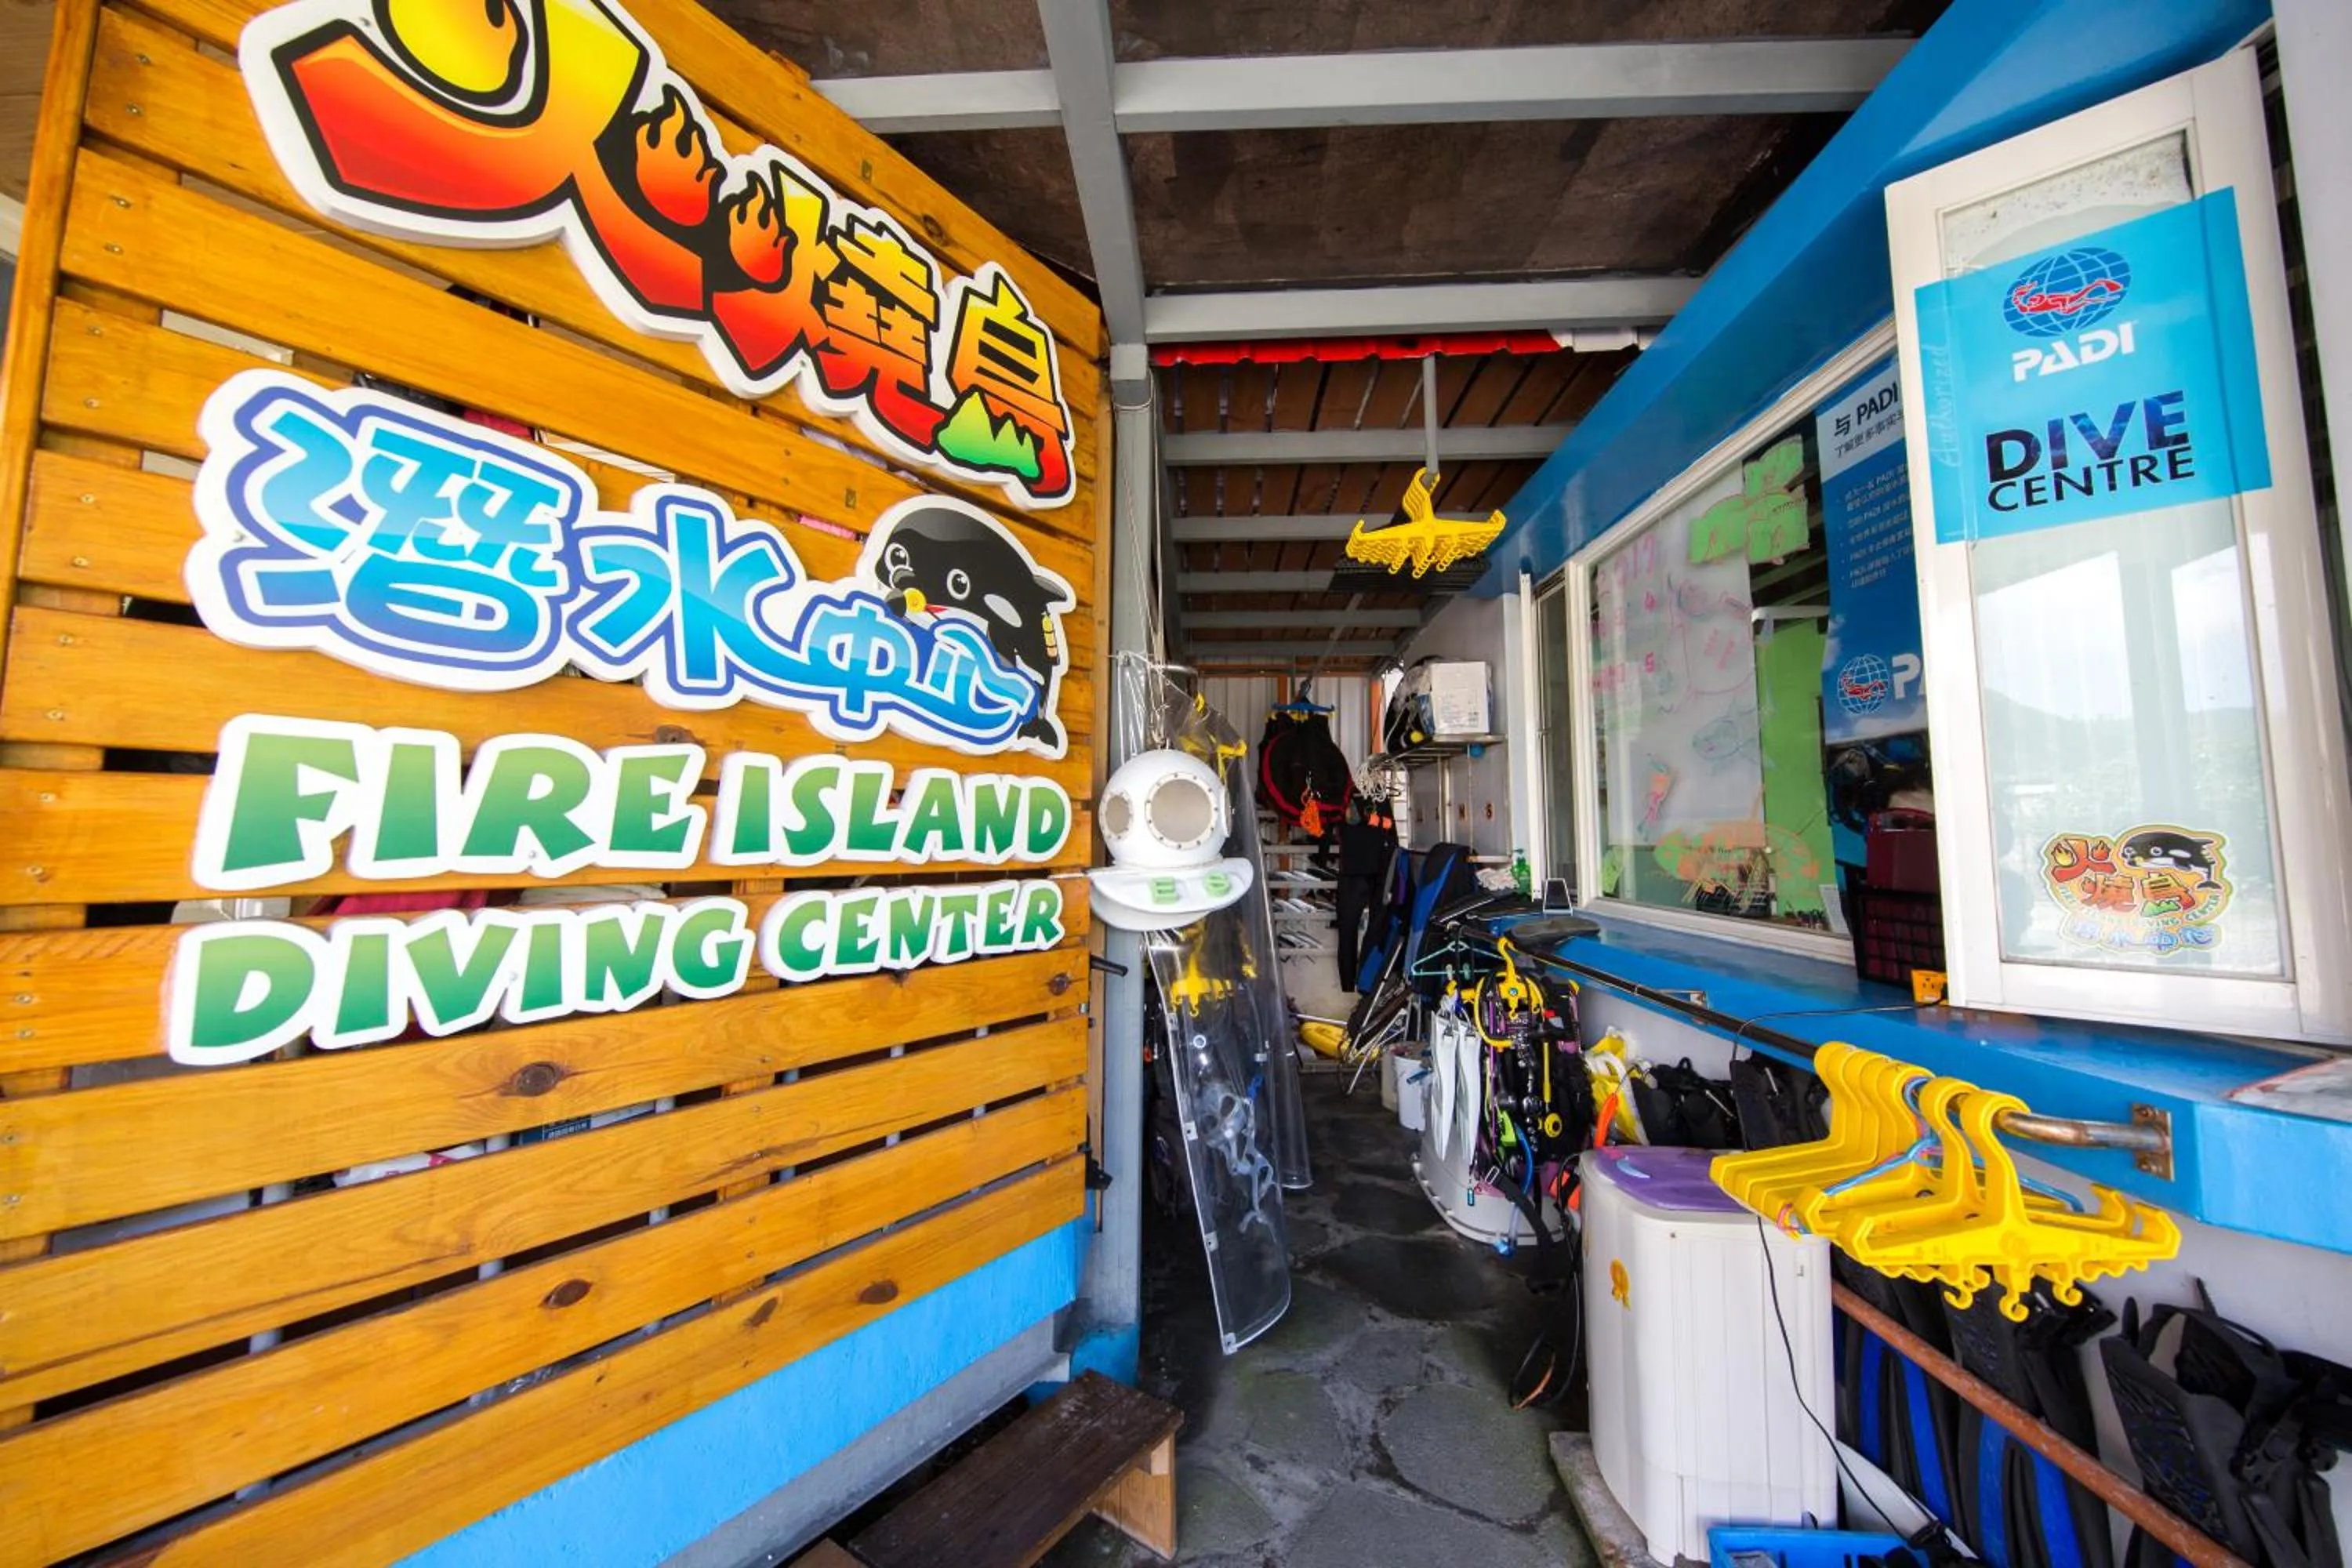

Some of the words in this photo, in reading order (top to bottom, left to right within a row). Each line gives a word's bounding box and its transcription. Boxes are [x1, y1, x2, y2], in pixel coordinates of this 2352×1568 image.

[267, 0, 1073, 502] 火燒島
[1856, 382, 1899, 427] PADI
[2011, 320, 2136, 383] PADI
[1984, 390, 2190, 484] DIVE
[1987, 445, 2196, 512] CENTRE
[226, 384, 1040, 743] 潛水中心
[221, 732, 695, 873] FIRE
[729, 764, 1068, 857] ISLAND
[190, 916, 750, 1049] DIVING
[782, 886, 1063, 974] CENTER
